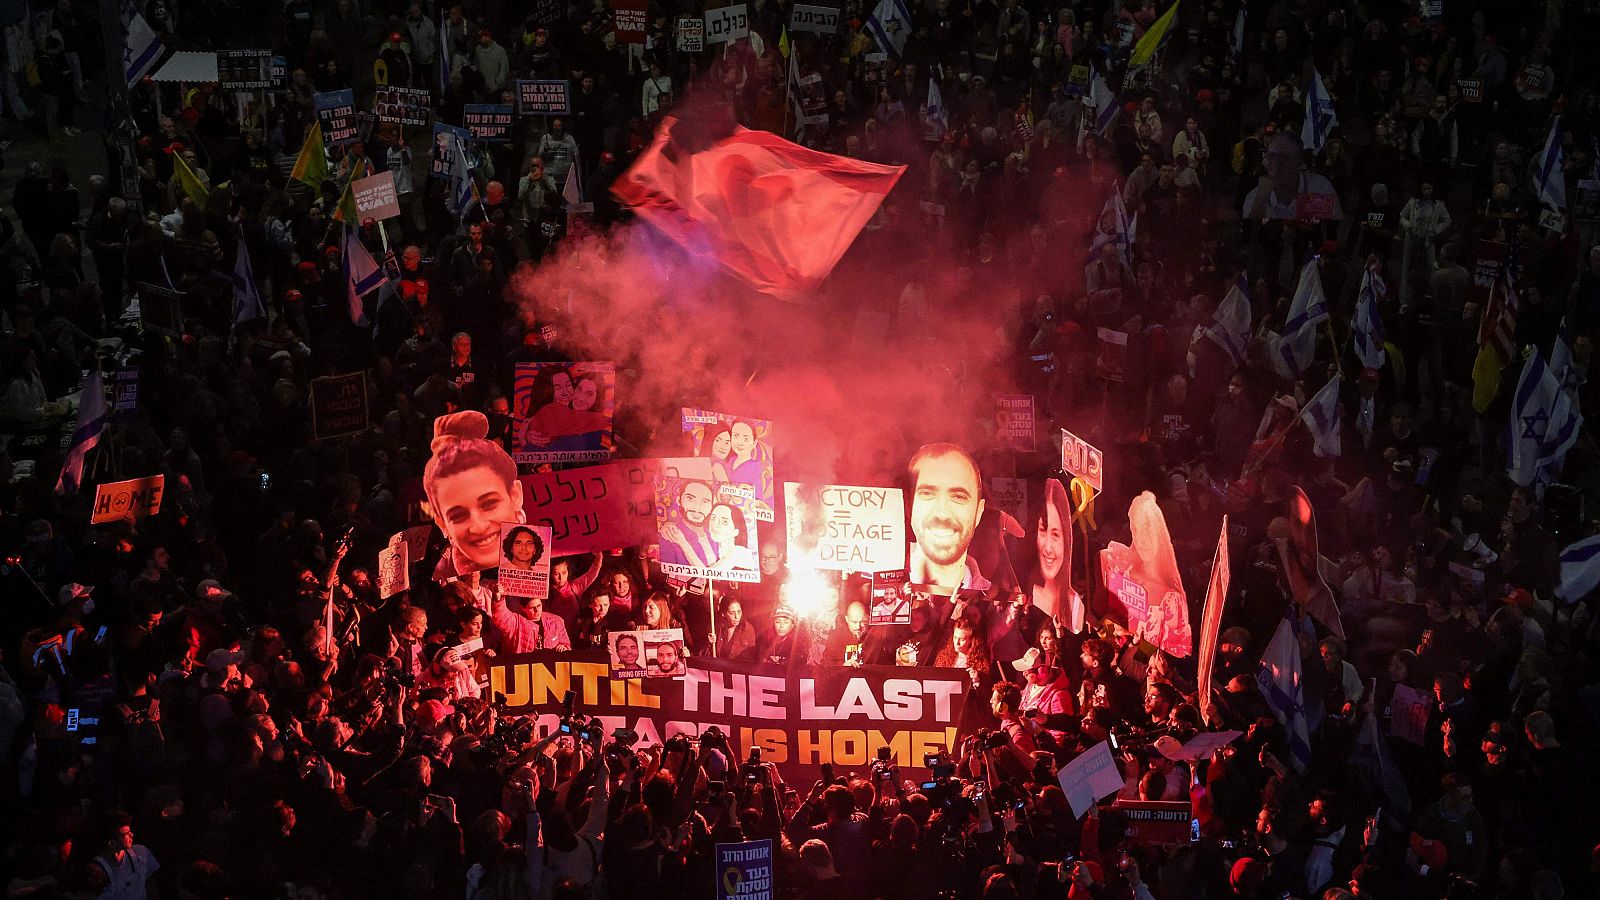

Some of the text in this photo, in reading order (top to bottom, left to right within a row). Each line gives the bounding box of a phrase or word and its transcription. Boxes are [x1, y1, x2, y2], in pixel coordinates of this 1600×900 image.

[616, 21, 645, 32] WAR
[793, 12, 838, 27] הביתה
[522, 84, 564, 93] עצרו את
[522, 92, 565, 103] המלחמה
[440, 147, 455, 162] TH
[357, 195, 394, 212] WAR
[1012, 412, 1032, 421] בעד
[553, 453, 577, 463] אותה
[579, 452, 610, 462] החזירו
[530, 474, 608, 507] כולנו
[756, 510, 773, 521] החז
[820, 545, 876, 563] DEAL
[664, 563, 757, 582] החזירו אותו הביתה!
[518, 589, 548, 597] WARRANT!
[491, 661, 963, 723] UNTIL THE LAST
[740, 727, 788, 764] IS
[798, 726, 957, 769] HOME!
[1153, 811, 1189, 821] דרושה:
[722, 847, 769, 863] אנחנו הרוב
[746, 866, 770, 880] בעד
[736, 878, 770, 894] עסקת
